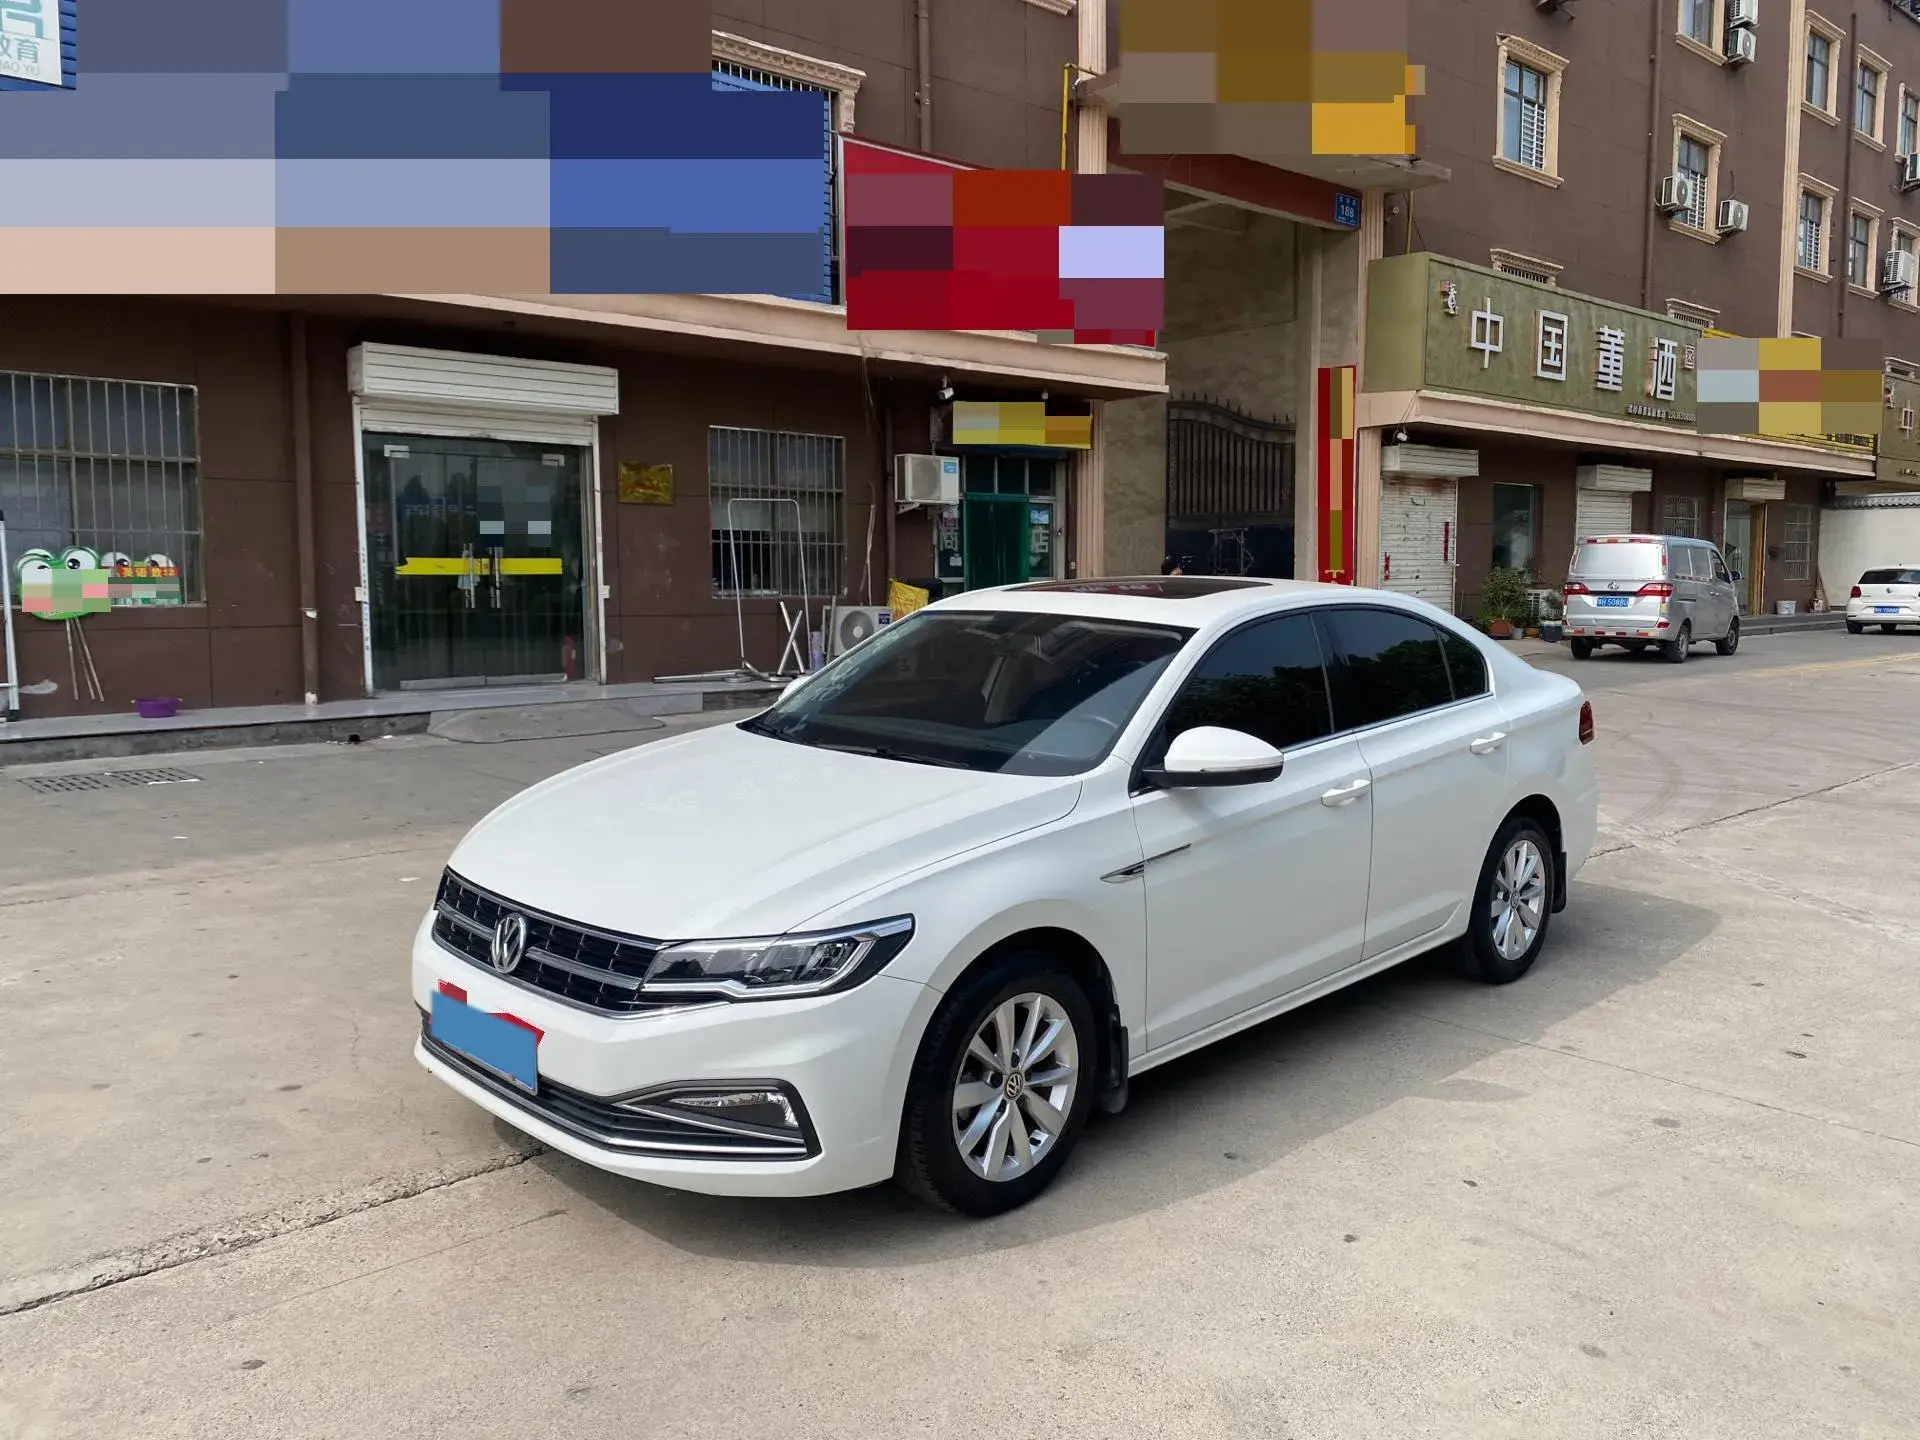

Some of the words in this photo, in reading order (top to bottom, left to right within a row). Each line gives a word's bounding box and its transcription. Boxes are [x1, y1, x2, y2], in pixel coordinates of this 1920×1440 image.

[1341, 204, 1354, 218] 188
[1471, 297, 1678, 401] 中国董酒
